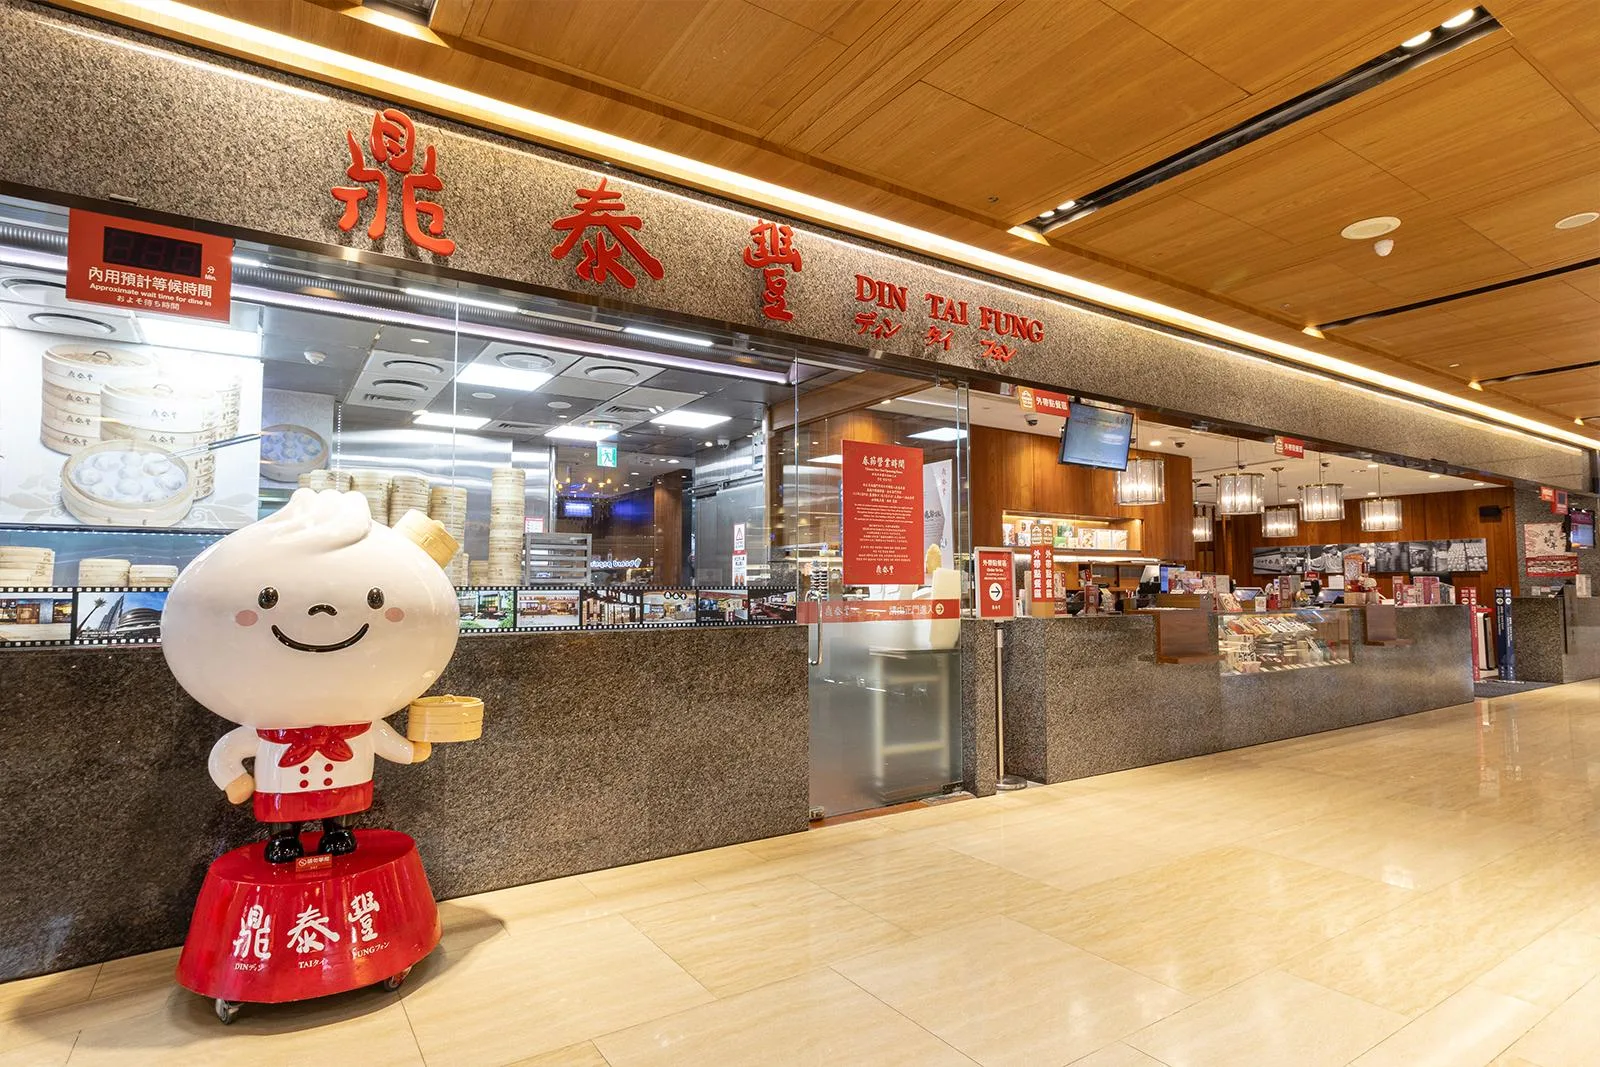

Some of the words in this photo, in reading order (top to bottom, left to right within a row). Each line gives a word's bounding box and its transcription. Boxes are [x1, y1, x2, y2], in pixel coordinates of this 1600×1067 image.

[90, 283, 139, 296] Approximate
[141, 291, 157, 299] wait
[158, 292, 175, 301] time
[175, 295, 186, 303] for
[187, 296, 204, 305] dine
[204, 299, 212, 307] in
[116, 295, 180, 310] およそ待ち時間
[855, 274, 907, 312] DIN
[925, 292, 969, 326] TAI
[979, 306, 1045, 343] FUNG
[854, 311, 902, 340] ディン
[925, 325, 954, 350] タイ
